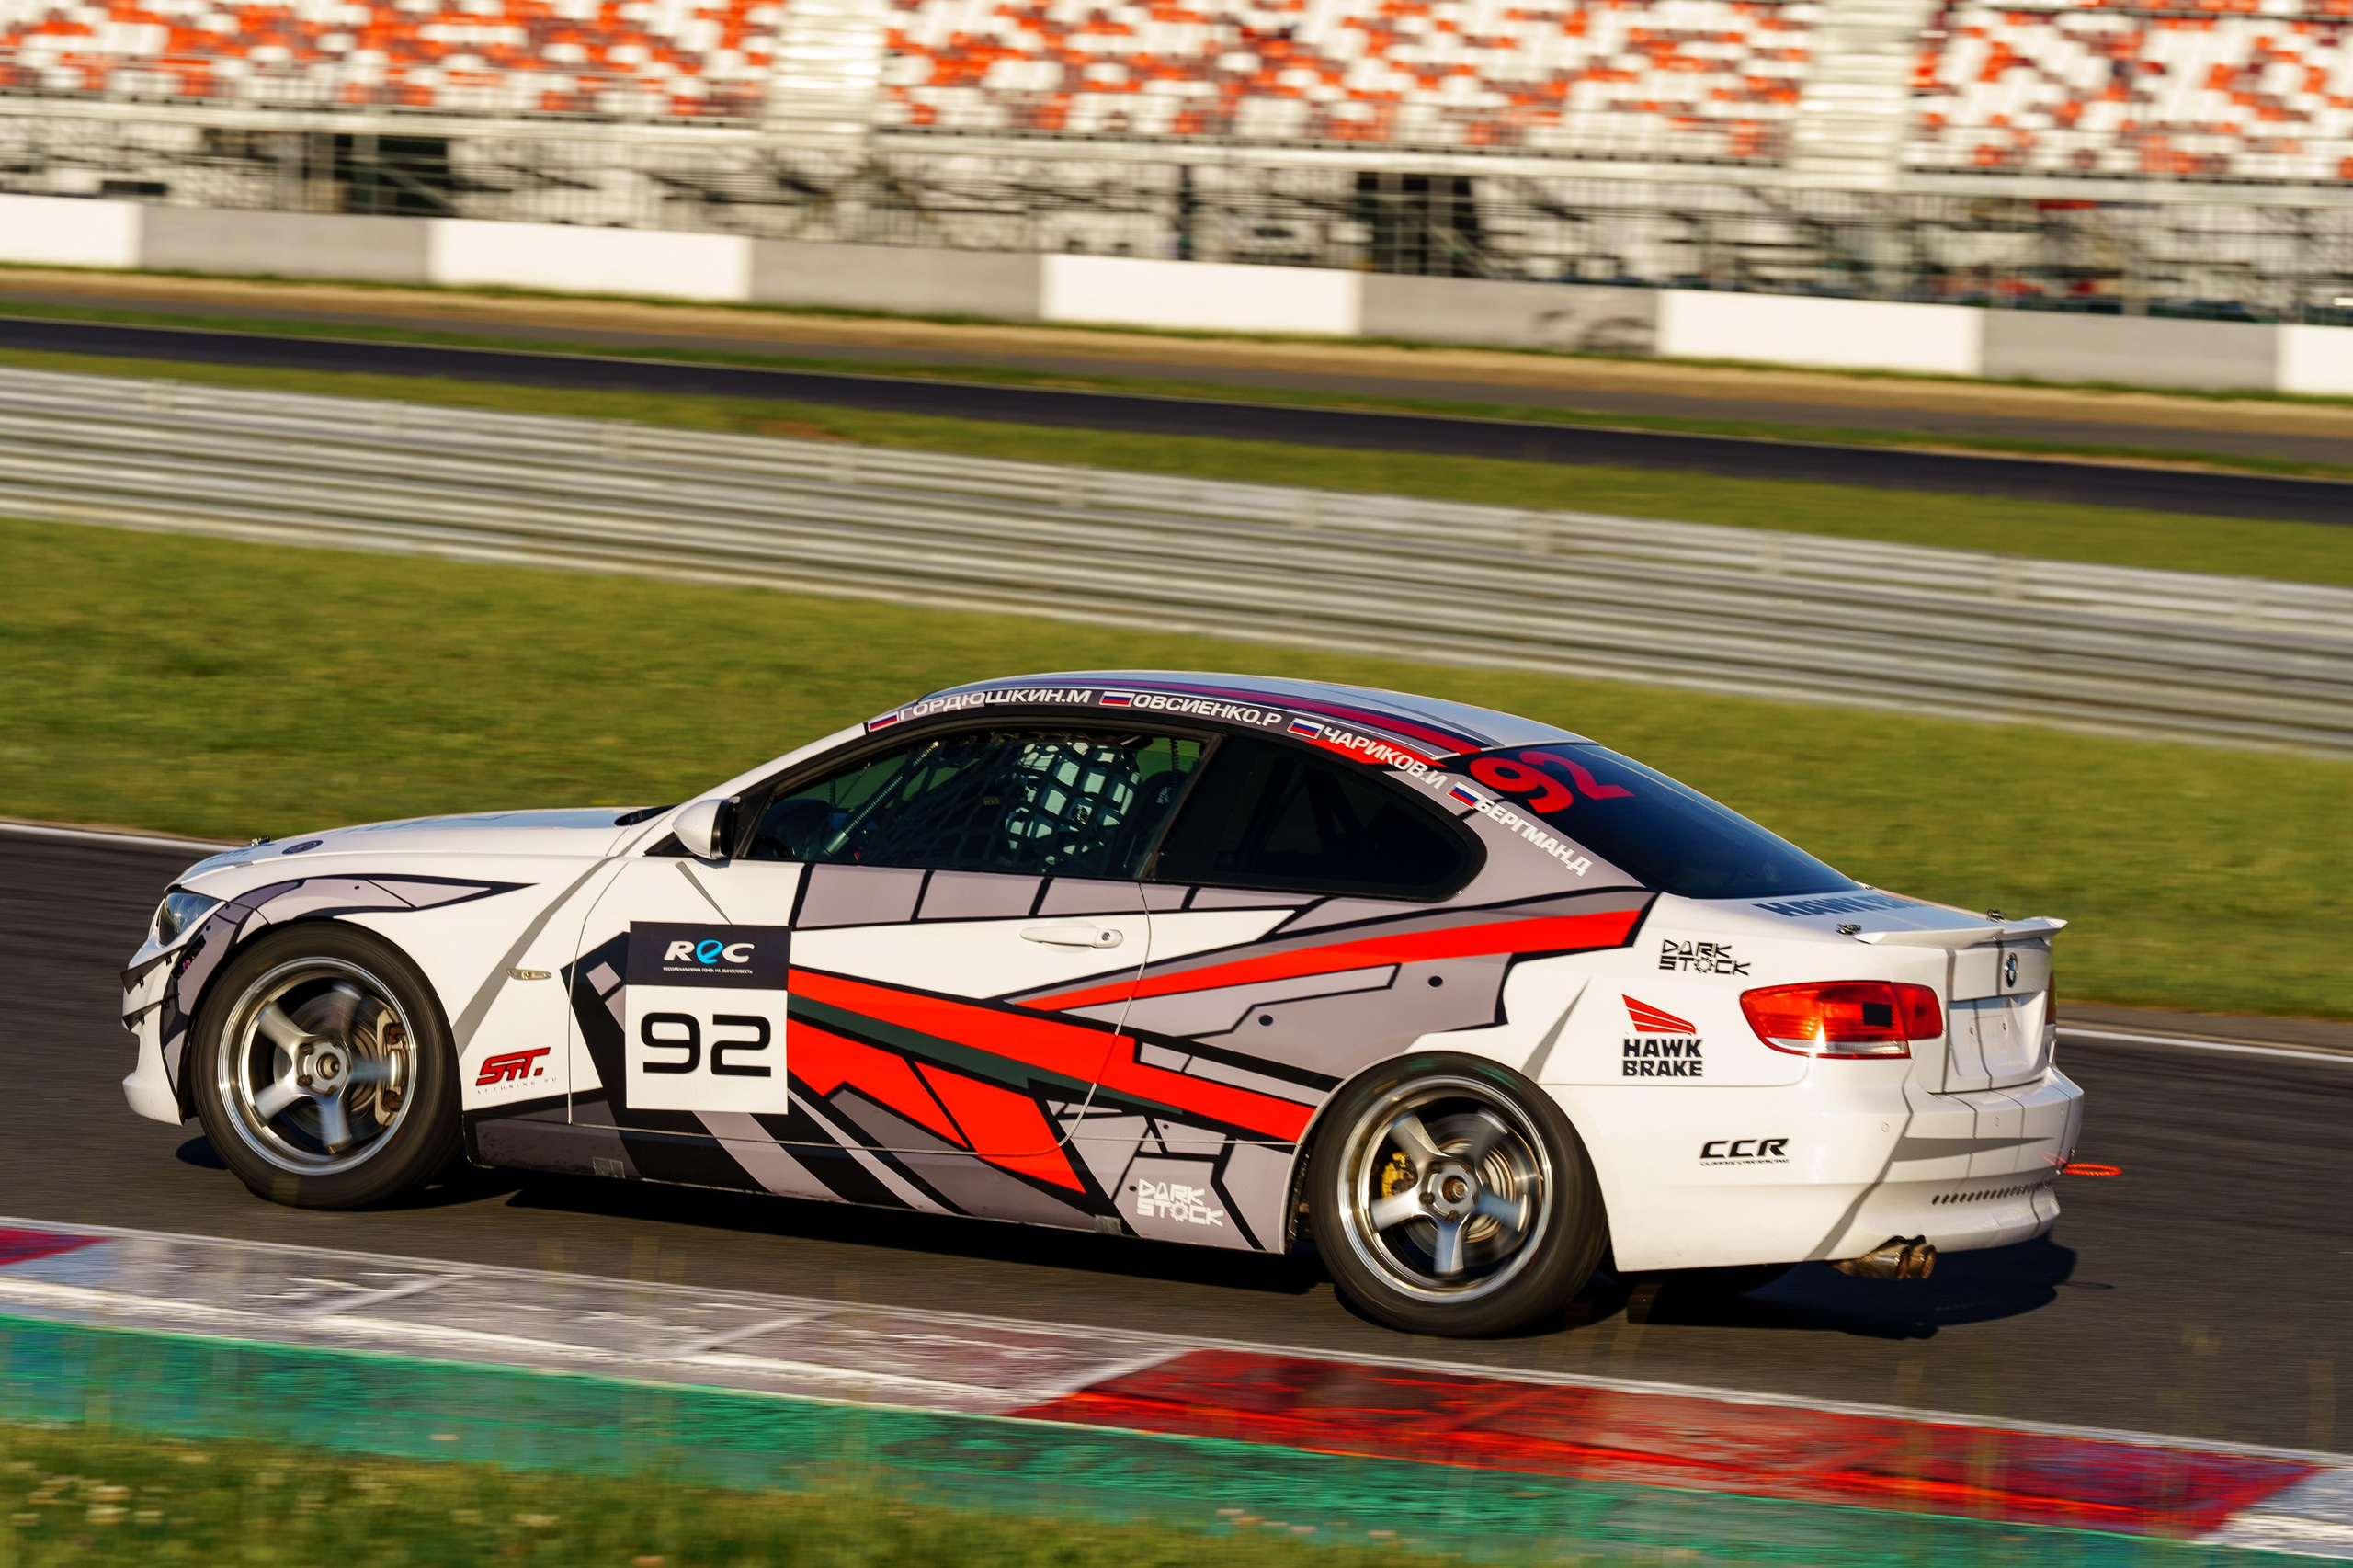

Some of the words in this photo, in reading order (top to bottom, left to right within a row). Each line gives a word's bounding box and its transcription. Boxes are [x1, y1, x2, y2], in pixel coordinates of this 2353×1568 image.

[900, 689, 1092, 721] ГОРДЮШКИН.М
[1132, 694, 1283, 727] ОВСИЕНКО.Р
[1324, 726, 1449, 790] ЧАРИКОВ.И
[1470, 750, 1636, 814] 92
[1661, 938, 1733, 959] DARK
[1657, 955, 1752, 976] STOCK
[641, 1012, 772, 1078] 92
[1622, 1038, 1704, 1058] HAWK
[1622, 1060, 1704, 1077] BRAKE
[1699, 1138, 1790, 1159] CCR
[1137, 1178, 1206, 1207] DARK
[1136, 1196, 1224, 1228] STOCK
